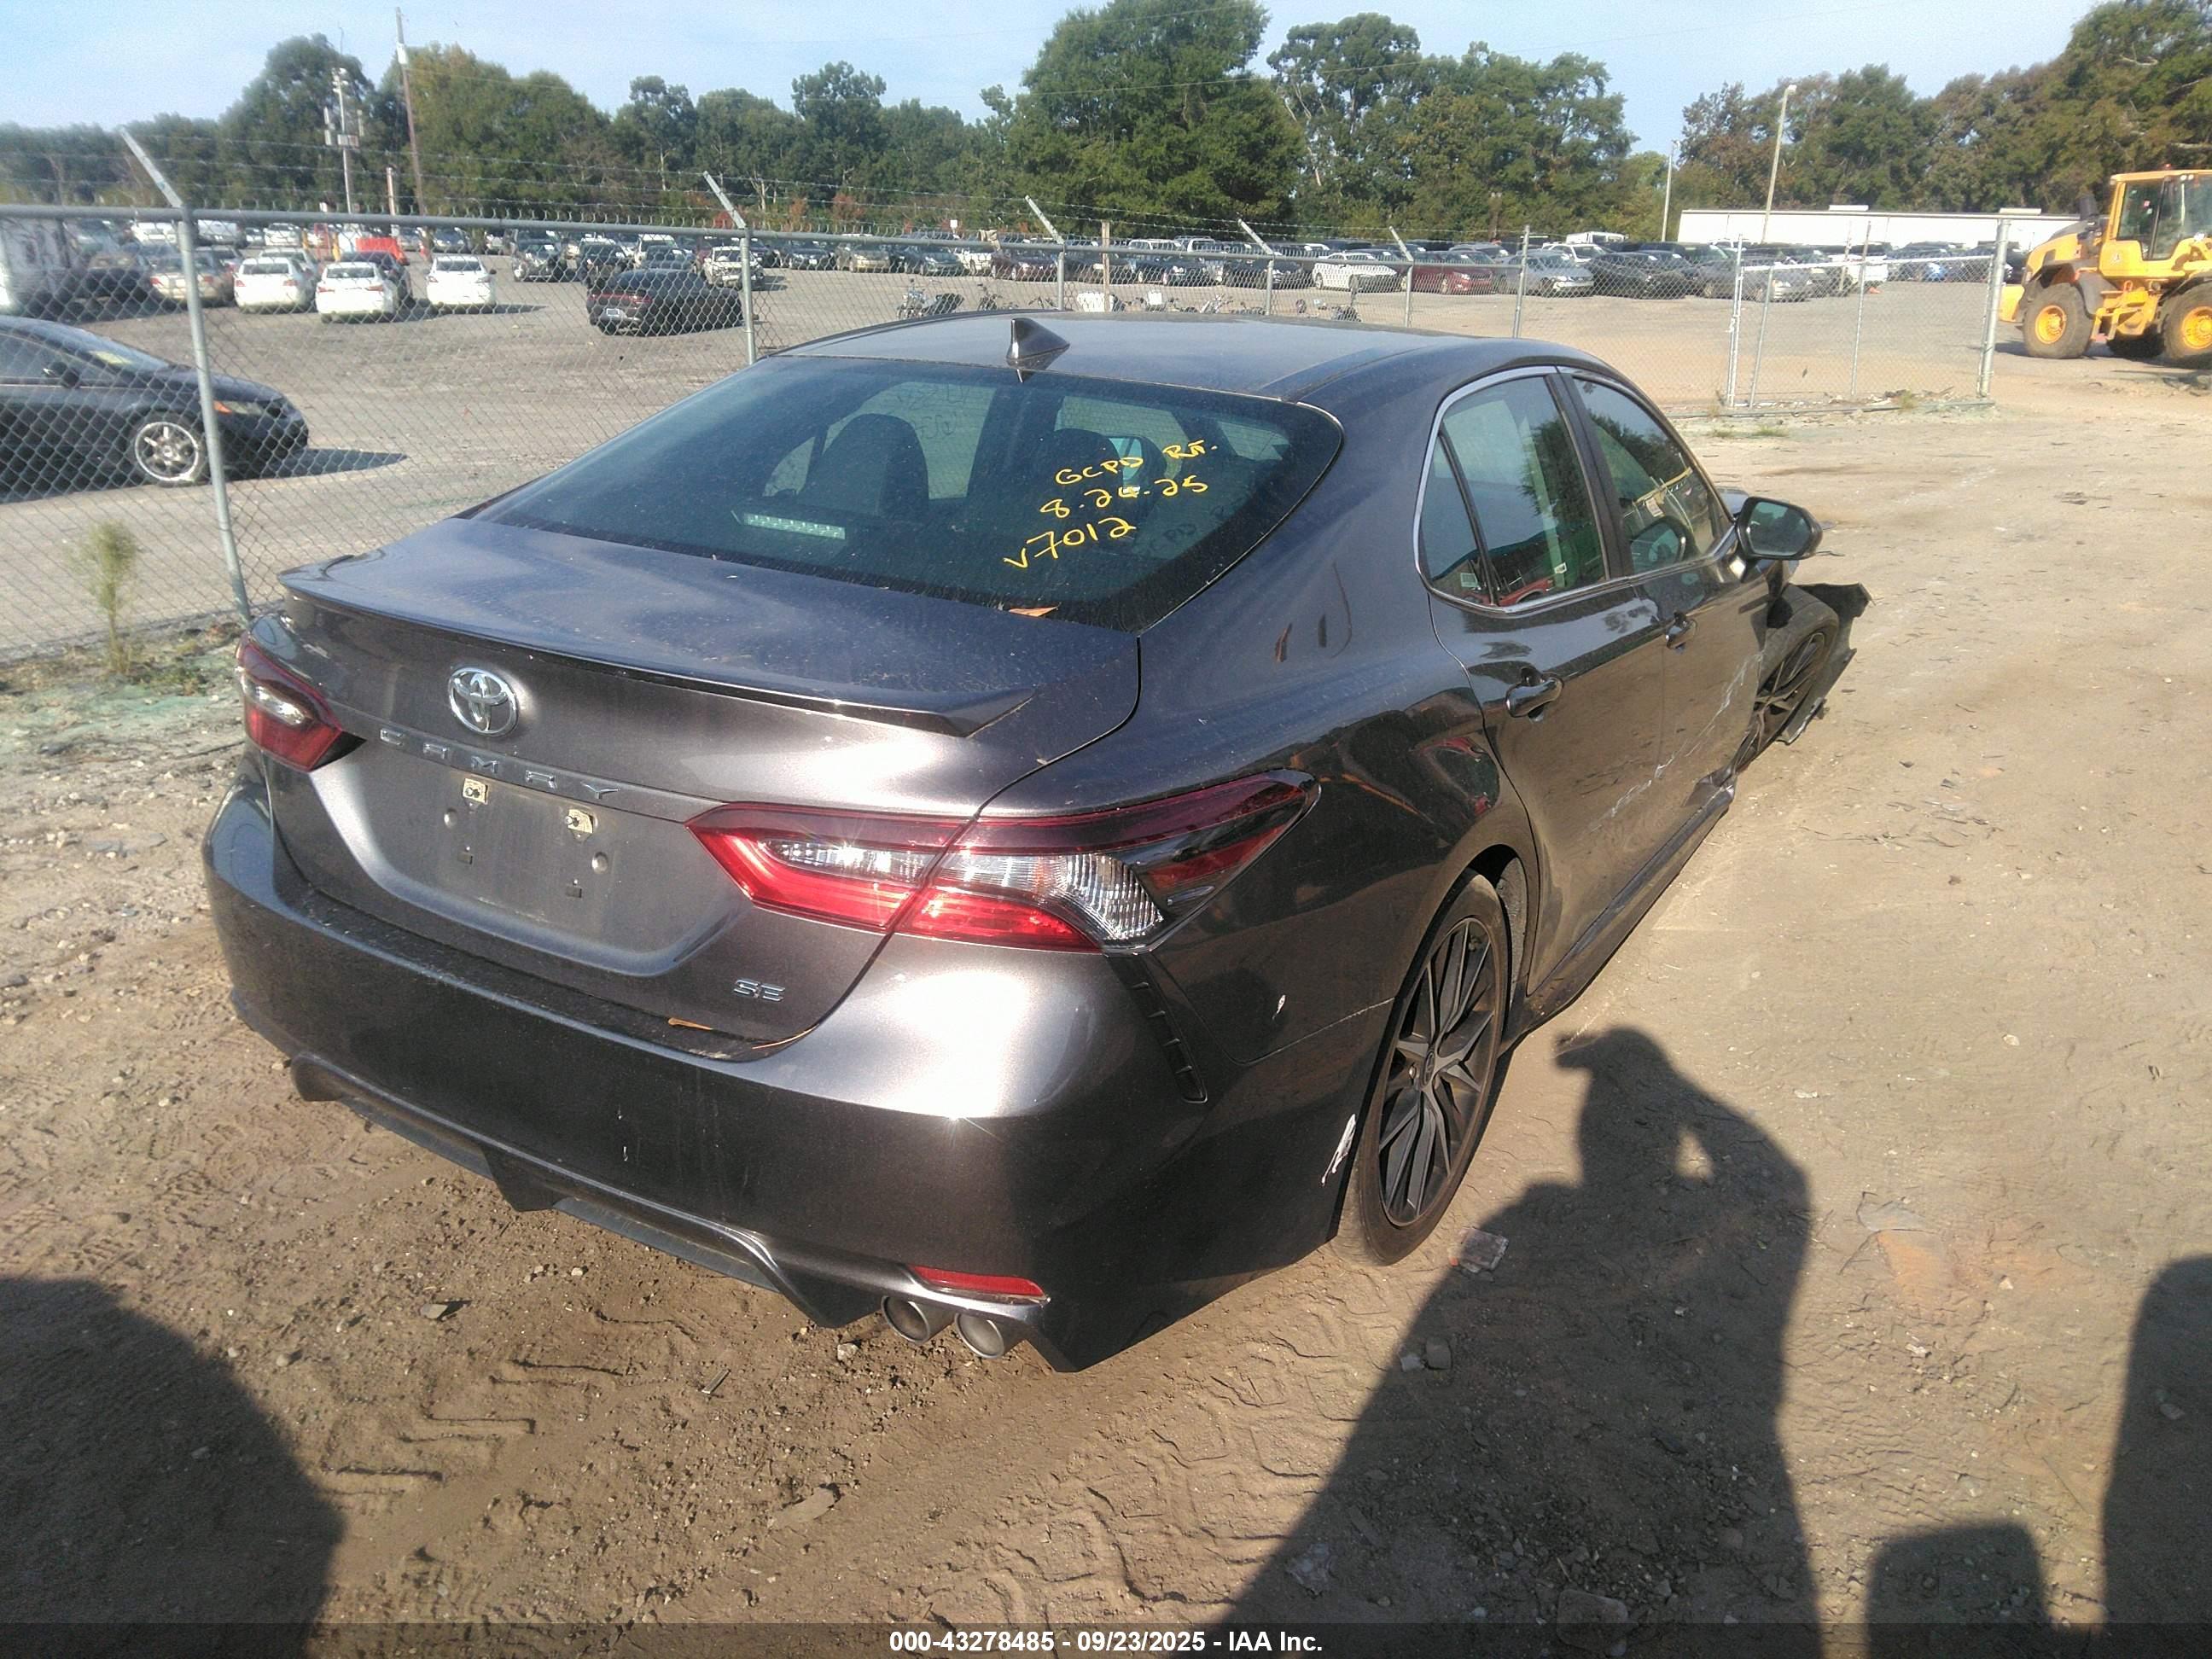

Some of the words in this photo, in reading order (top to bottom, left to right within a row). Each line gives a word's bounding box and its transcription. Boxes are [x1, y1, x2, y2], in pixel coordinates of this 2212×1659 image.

[1056, 457, 1144, 485] GCPD
[380, 728, 621, 800] CAMRY
[734, 978, 786, 1003] SE
